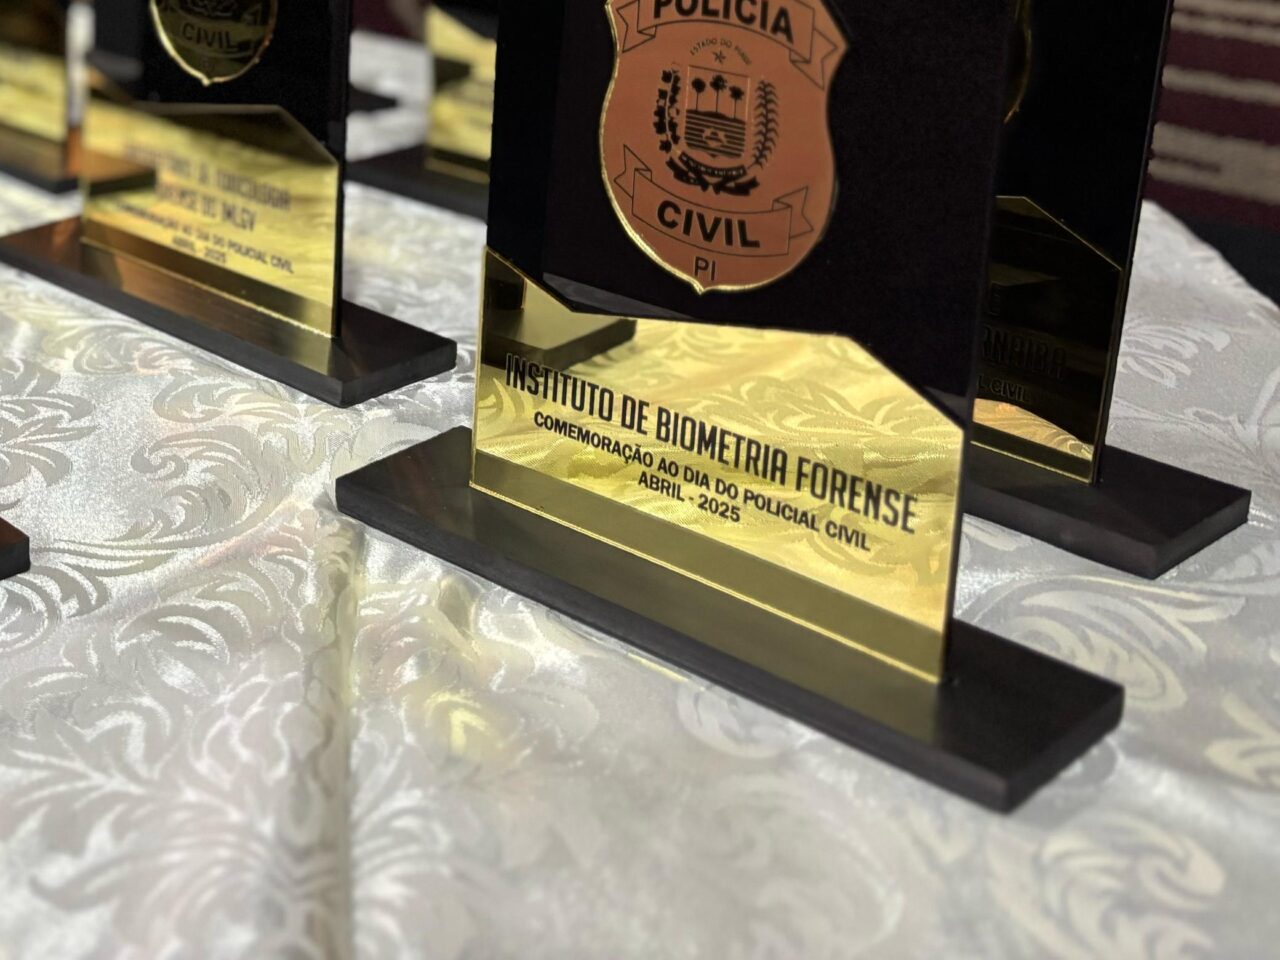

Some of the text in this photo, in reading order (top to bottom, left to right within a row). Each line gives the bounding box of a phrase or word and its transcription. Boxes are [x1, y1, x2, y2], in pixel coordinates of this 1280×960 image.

[182, 22, 238, 50] CIVIL
[656, 199, 761, 249] CIVIL
[694, 255, 716, 282] PI
[505, 351, 919, 534] INSTITUTO DE BIOMETRIA FORENSE
[533, 410, 871, 552] COMEMORAÇÃO AO DIA DO POLICIAL CIVIL
[637, 470, 686, 502] ABRIL
[697, 493, 741, 523] 2025
